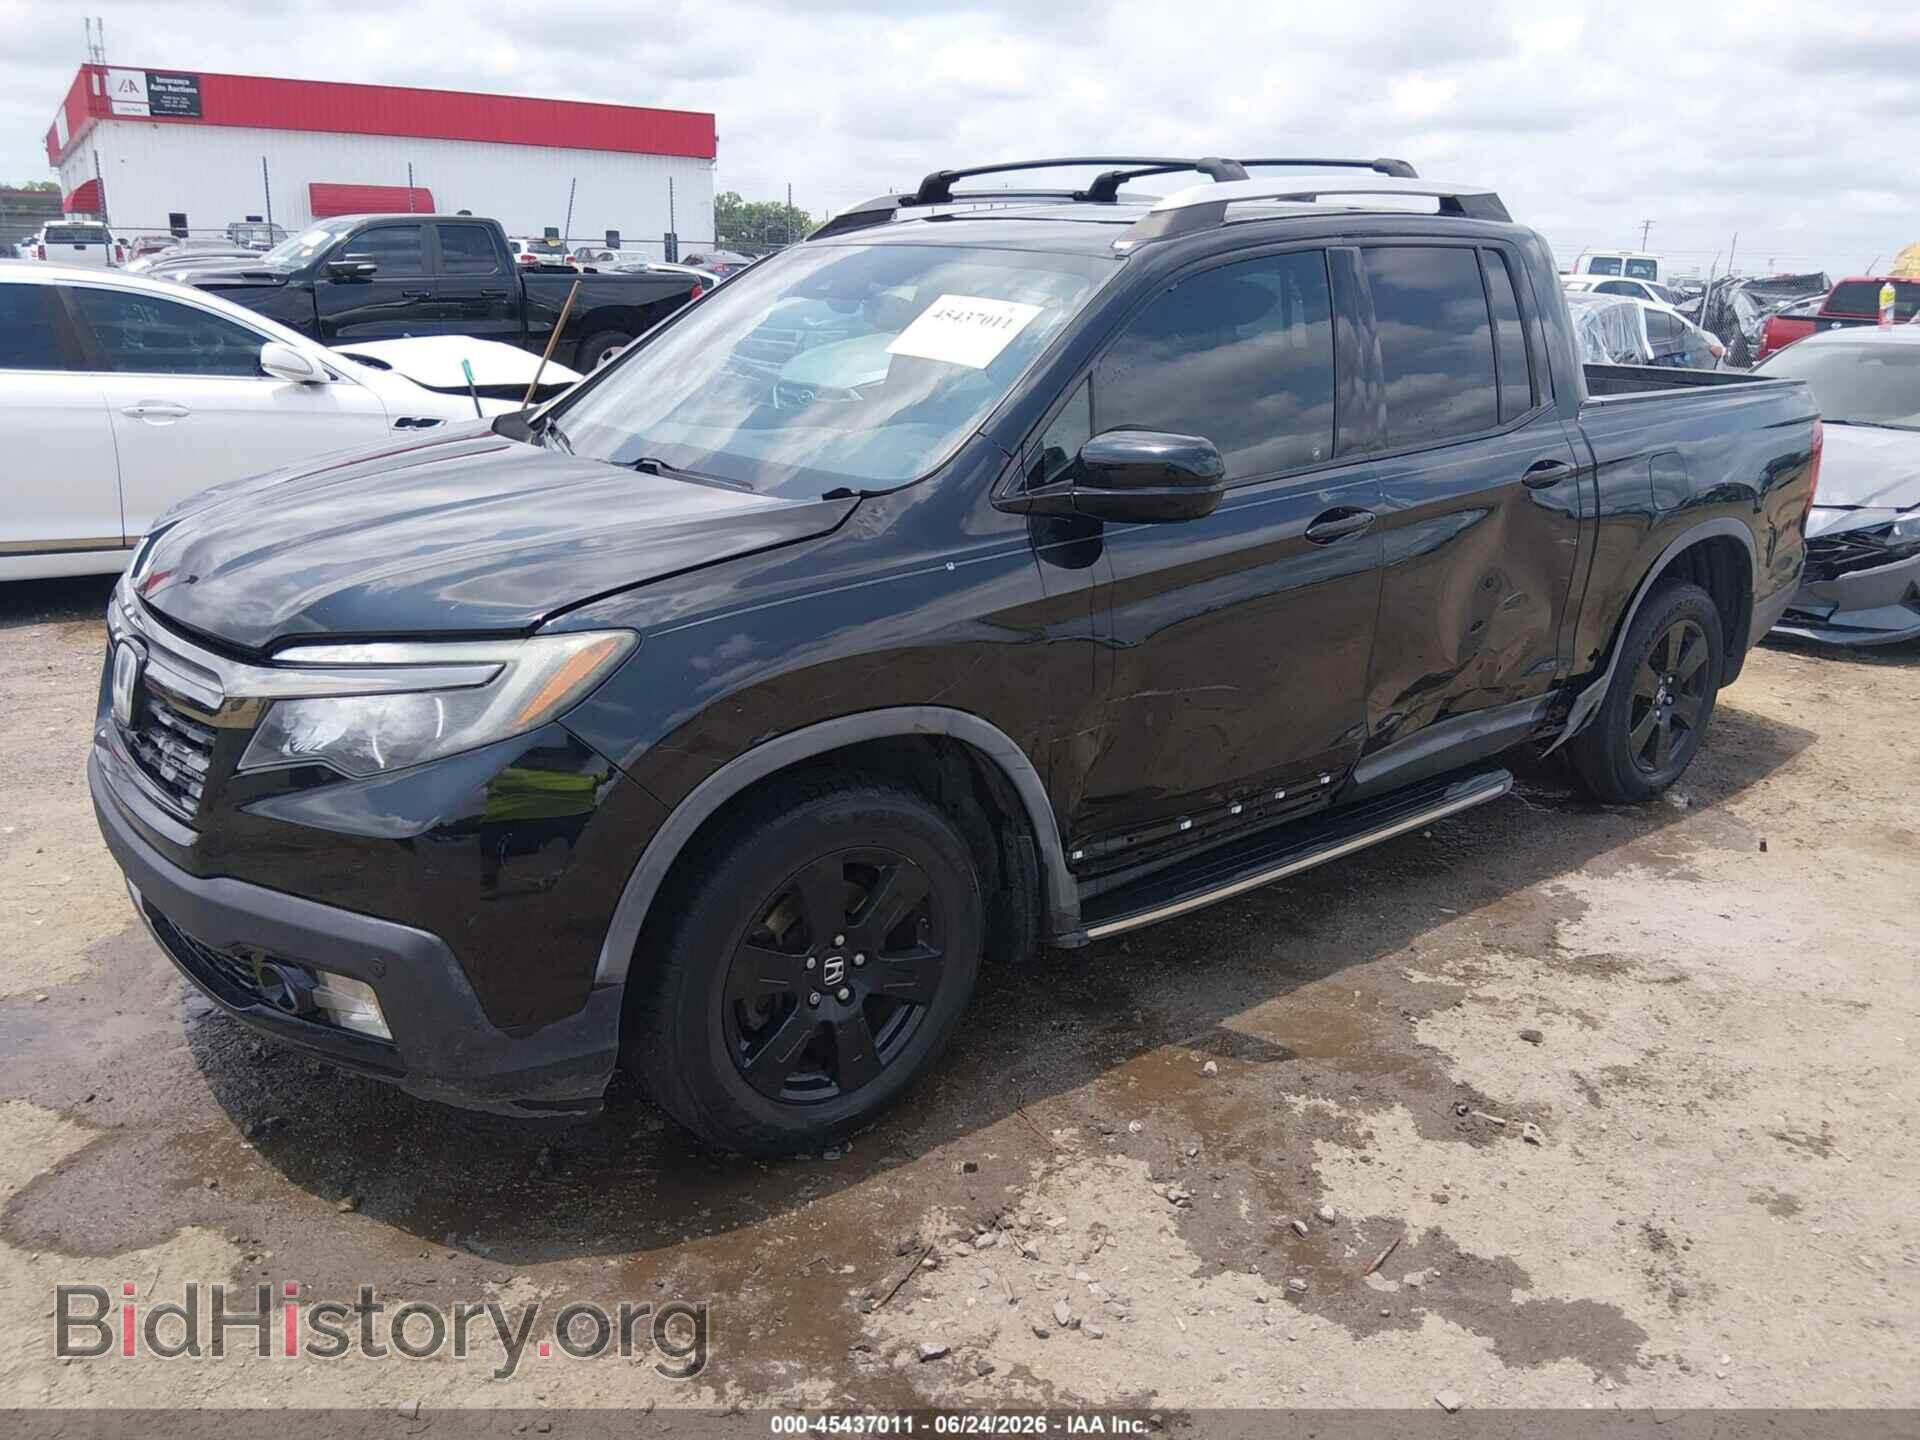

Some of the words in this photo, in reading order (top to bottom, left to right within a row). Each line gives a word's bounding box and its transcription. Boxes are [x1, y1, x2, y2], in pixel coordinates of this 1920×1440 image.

[150, 83, 167, 92] Auto
[167, 84, 198, 94] Auctions
[933, 309, 1013, 328] 45437011
